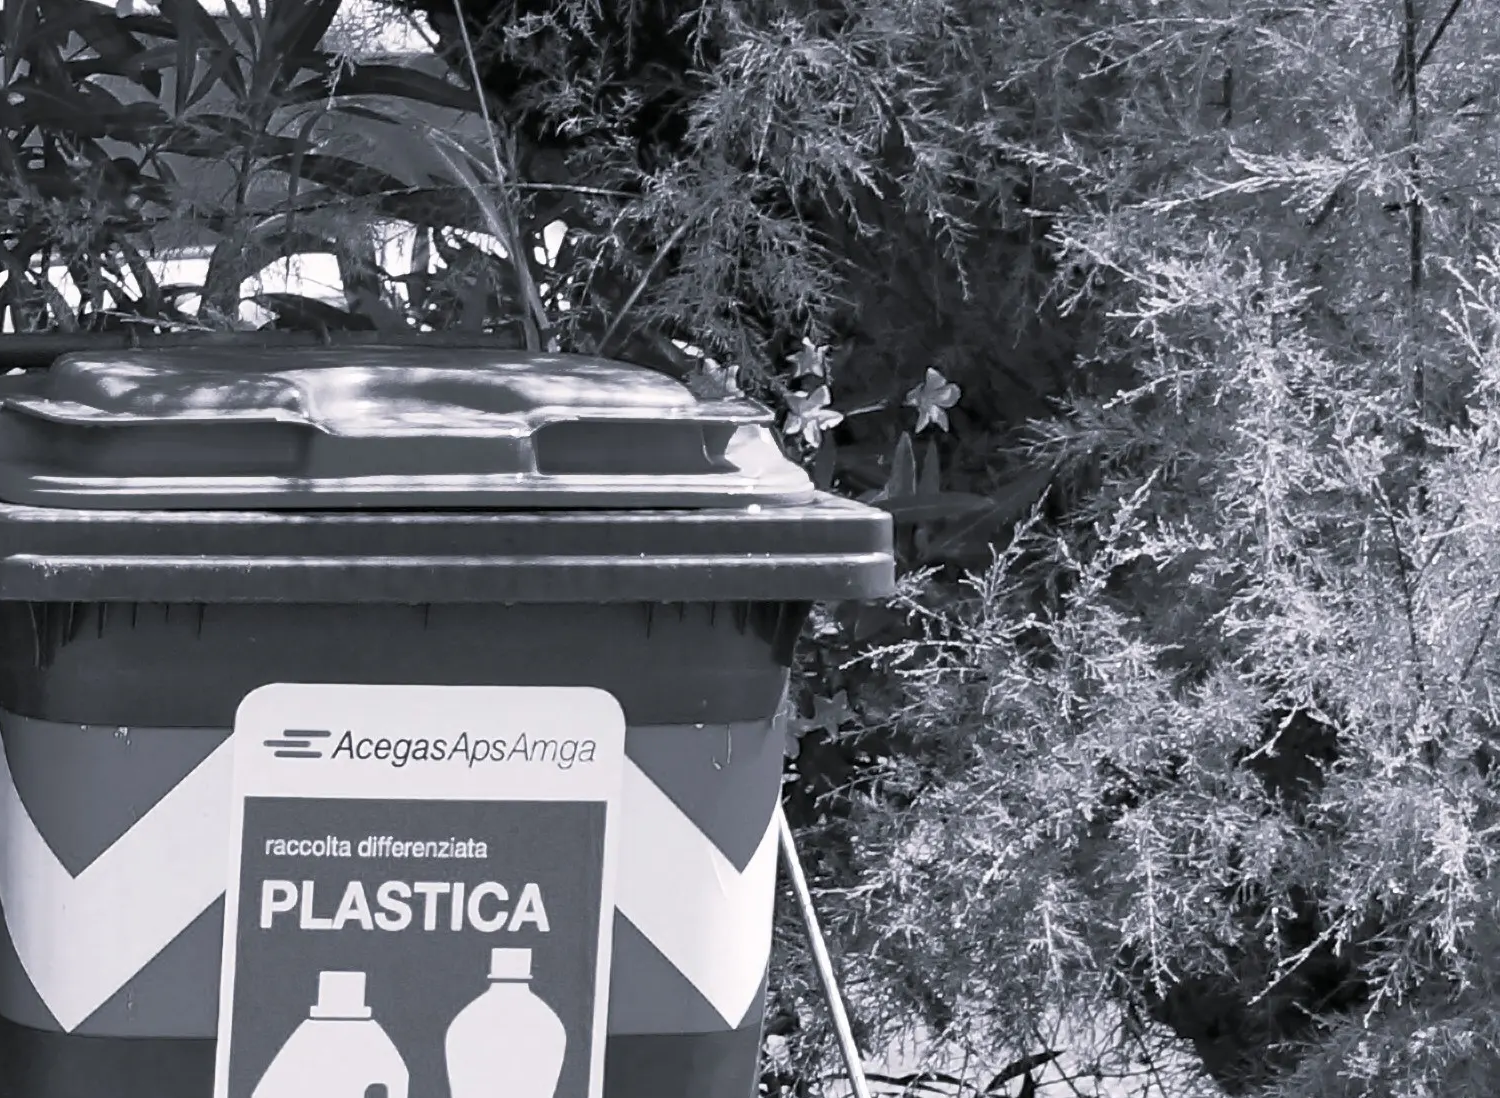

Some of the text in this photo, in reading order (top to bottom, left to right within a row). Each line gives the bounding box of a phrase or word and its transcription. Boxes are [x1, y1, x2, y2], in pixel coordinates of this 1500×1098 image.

[332, 730, 597, 770] AcegasApsAmga
[265, 836, 488, 858] raccolta differenziata
[259, 879, 551, 933] PLASTICA
